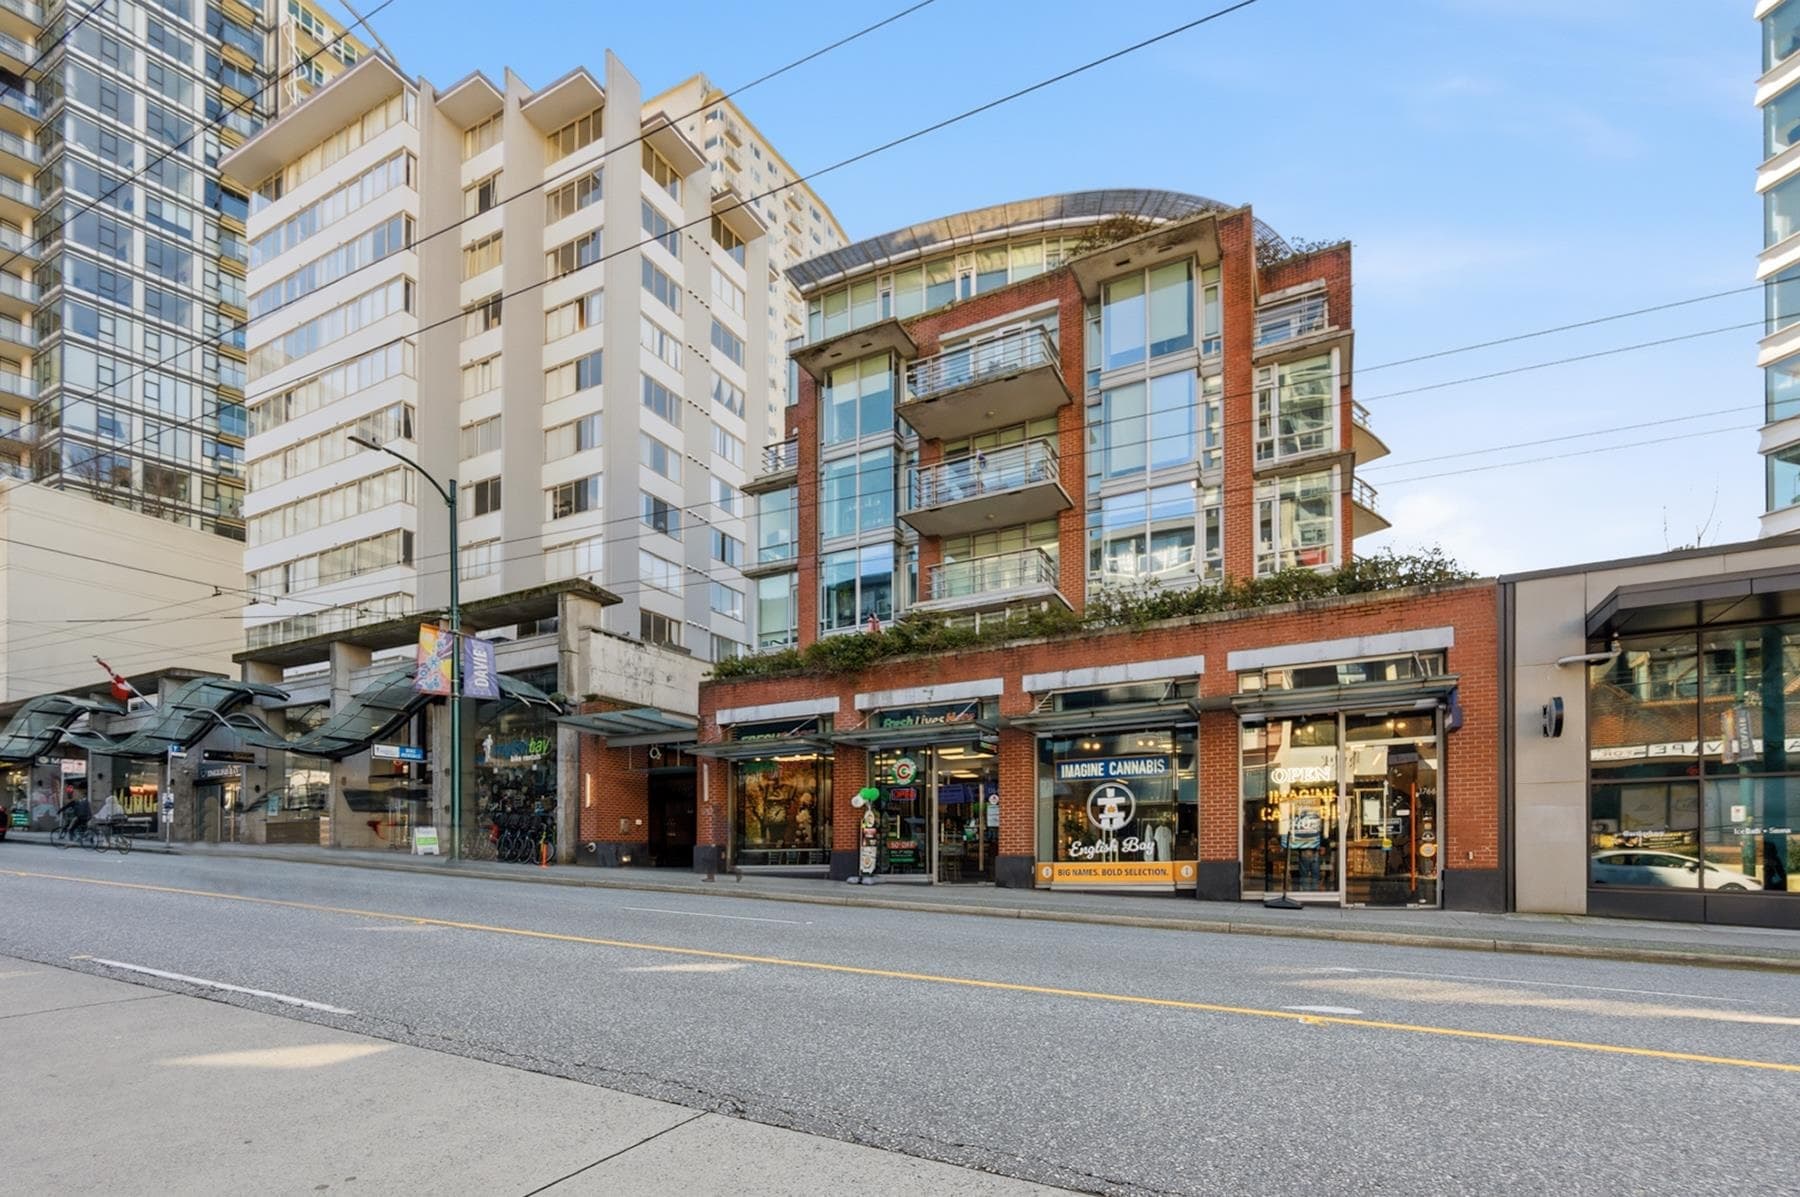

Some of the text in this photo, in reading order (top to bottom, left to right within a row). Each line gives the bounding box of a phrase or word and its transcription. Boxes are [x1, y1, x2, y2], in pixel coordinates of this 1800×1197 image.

[472, 648, 489, 688] DAVIE
[915, 715, 945, 726] Lives
[1061, 759, 1165, 778] IMAGINE CANNABIS
[1271, 766, 1330, 783] OPEN
[1068, 836, 1155, 859] English Bay
[1057, 868, 1168, 876] BIG NAMES. BOLD SELECTION.
